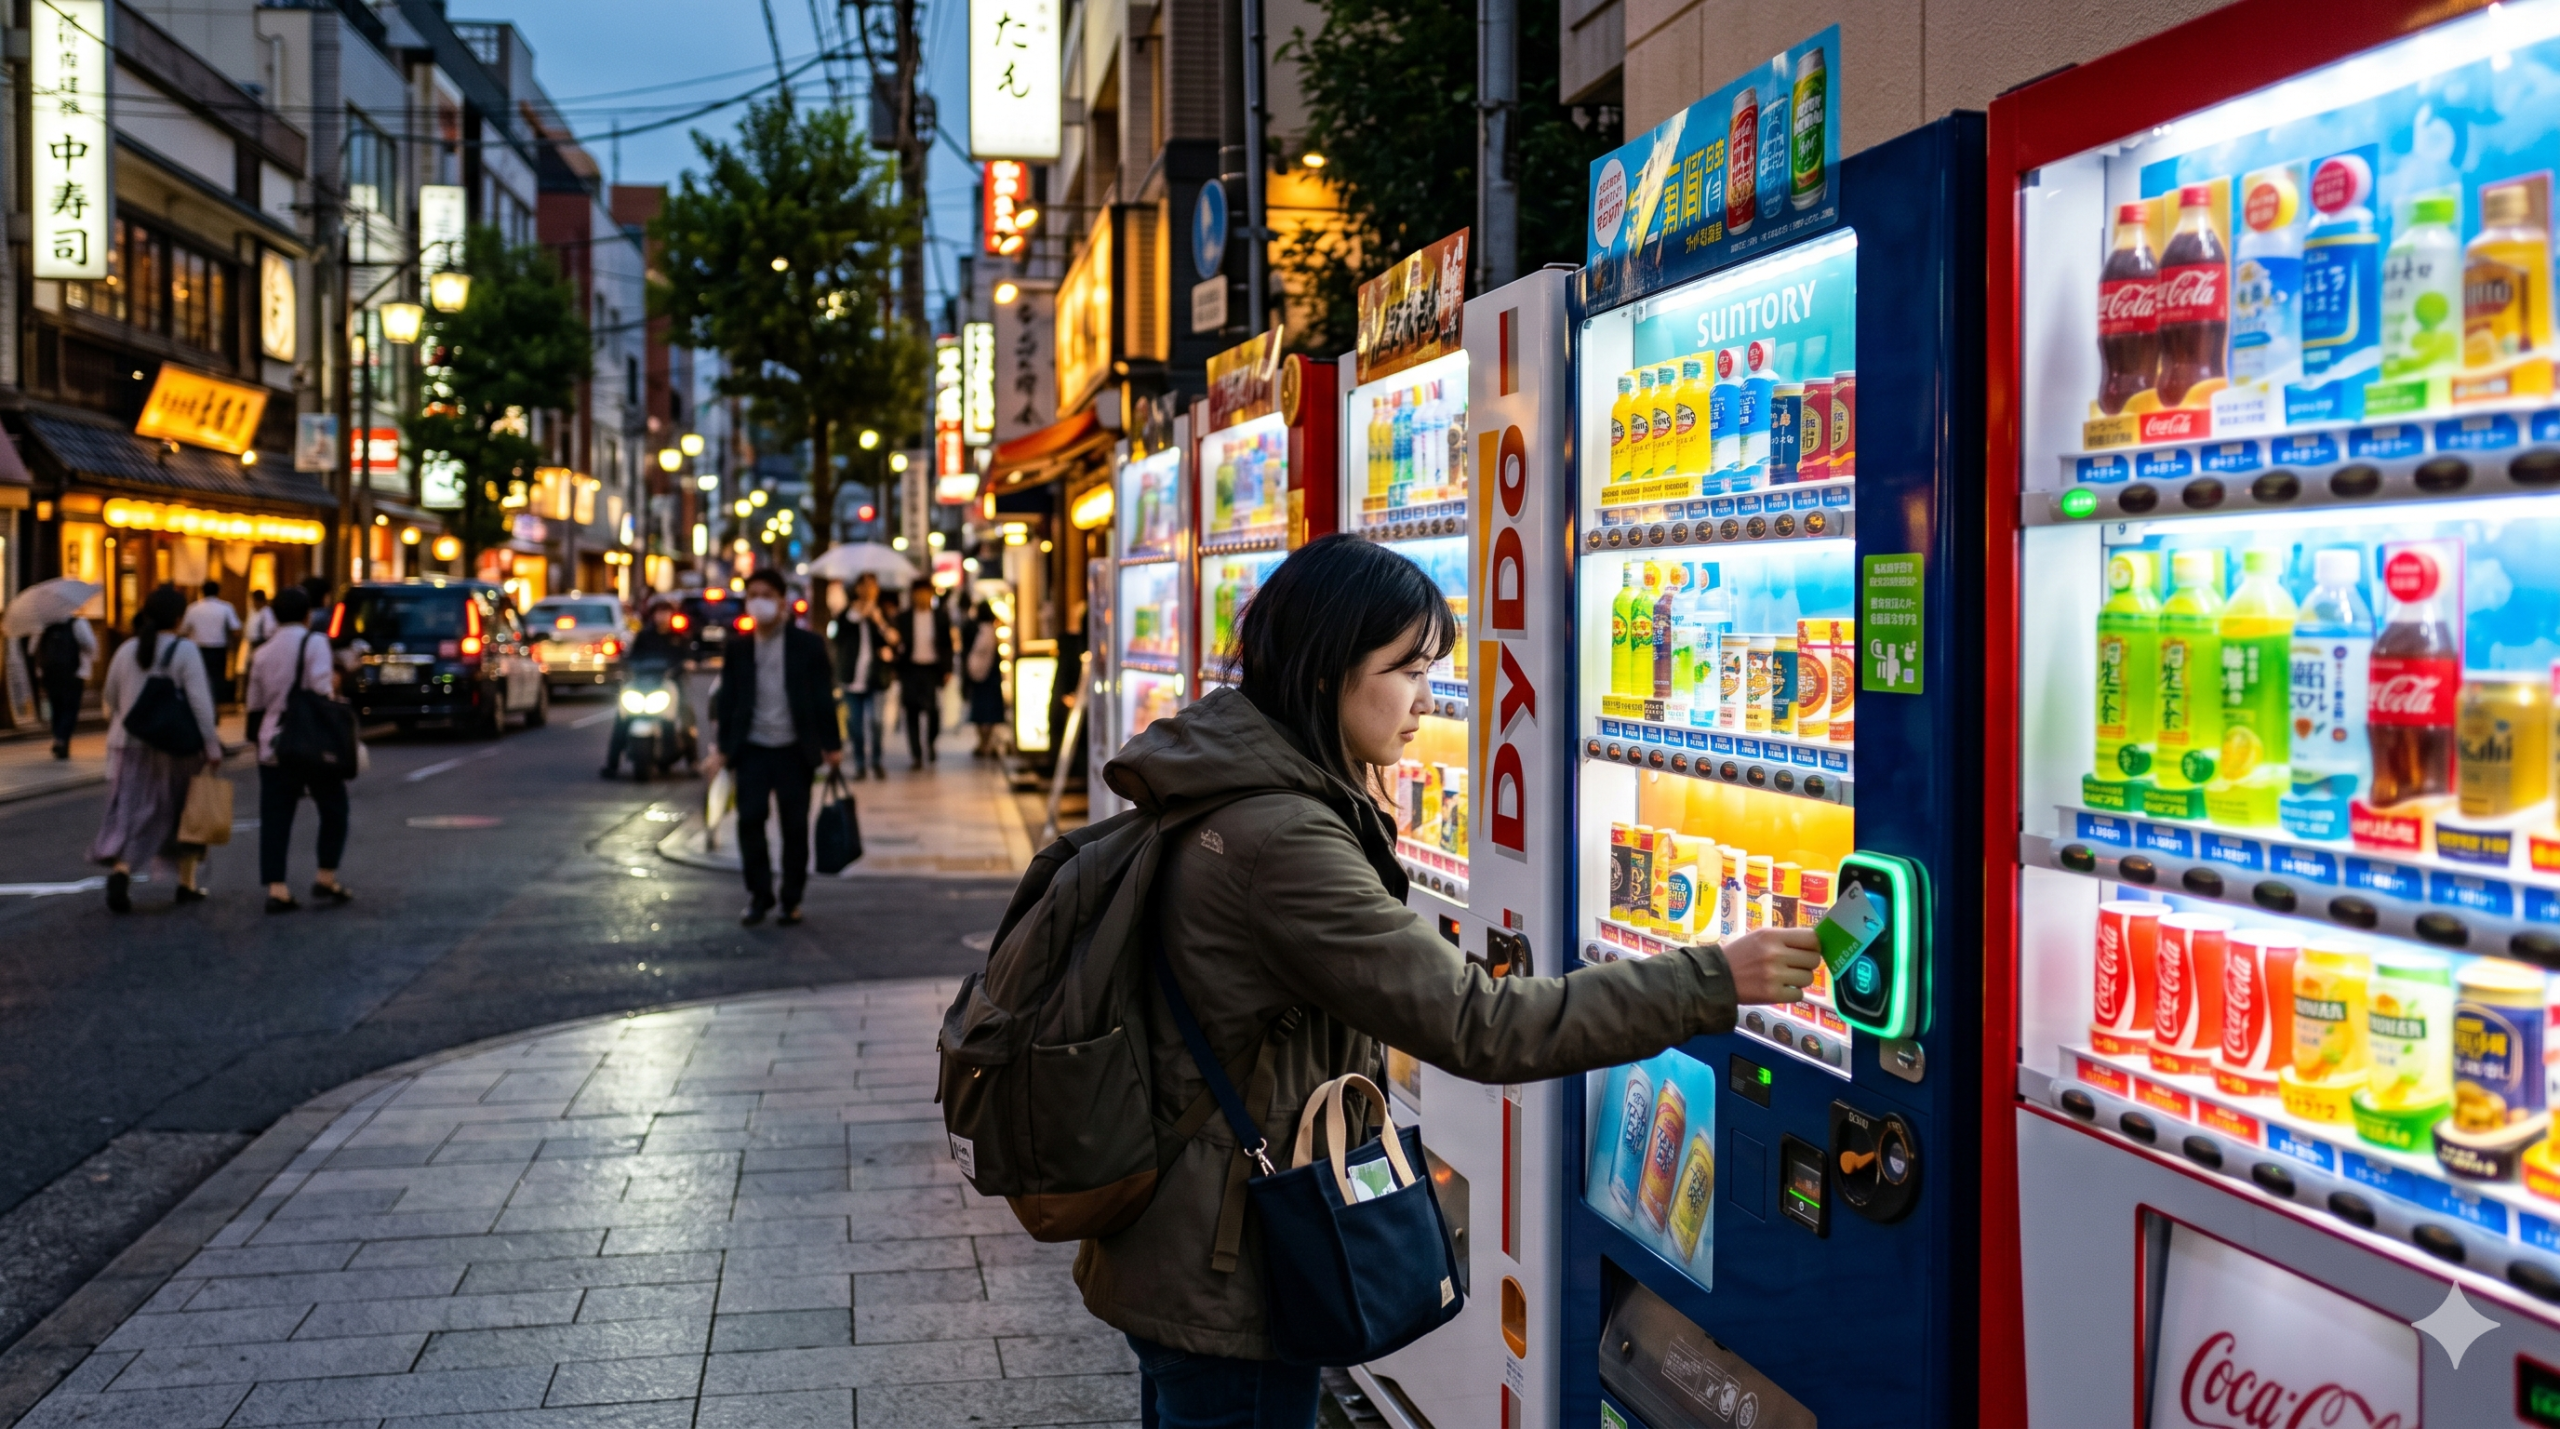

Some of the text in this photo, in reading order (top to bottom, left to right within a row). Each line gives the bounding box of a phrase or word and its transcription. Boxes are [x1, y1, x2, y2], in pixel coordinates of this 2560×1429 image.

[49, 133, 89, 266] 中寿司
[1697, 279, 1816, 348] SUNTORY
[1491, 424, 1538, 853] DYDO
[2181, 1331, 2420, 1429] Coca-C
